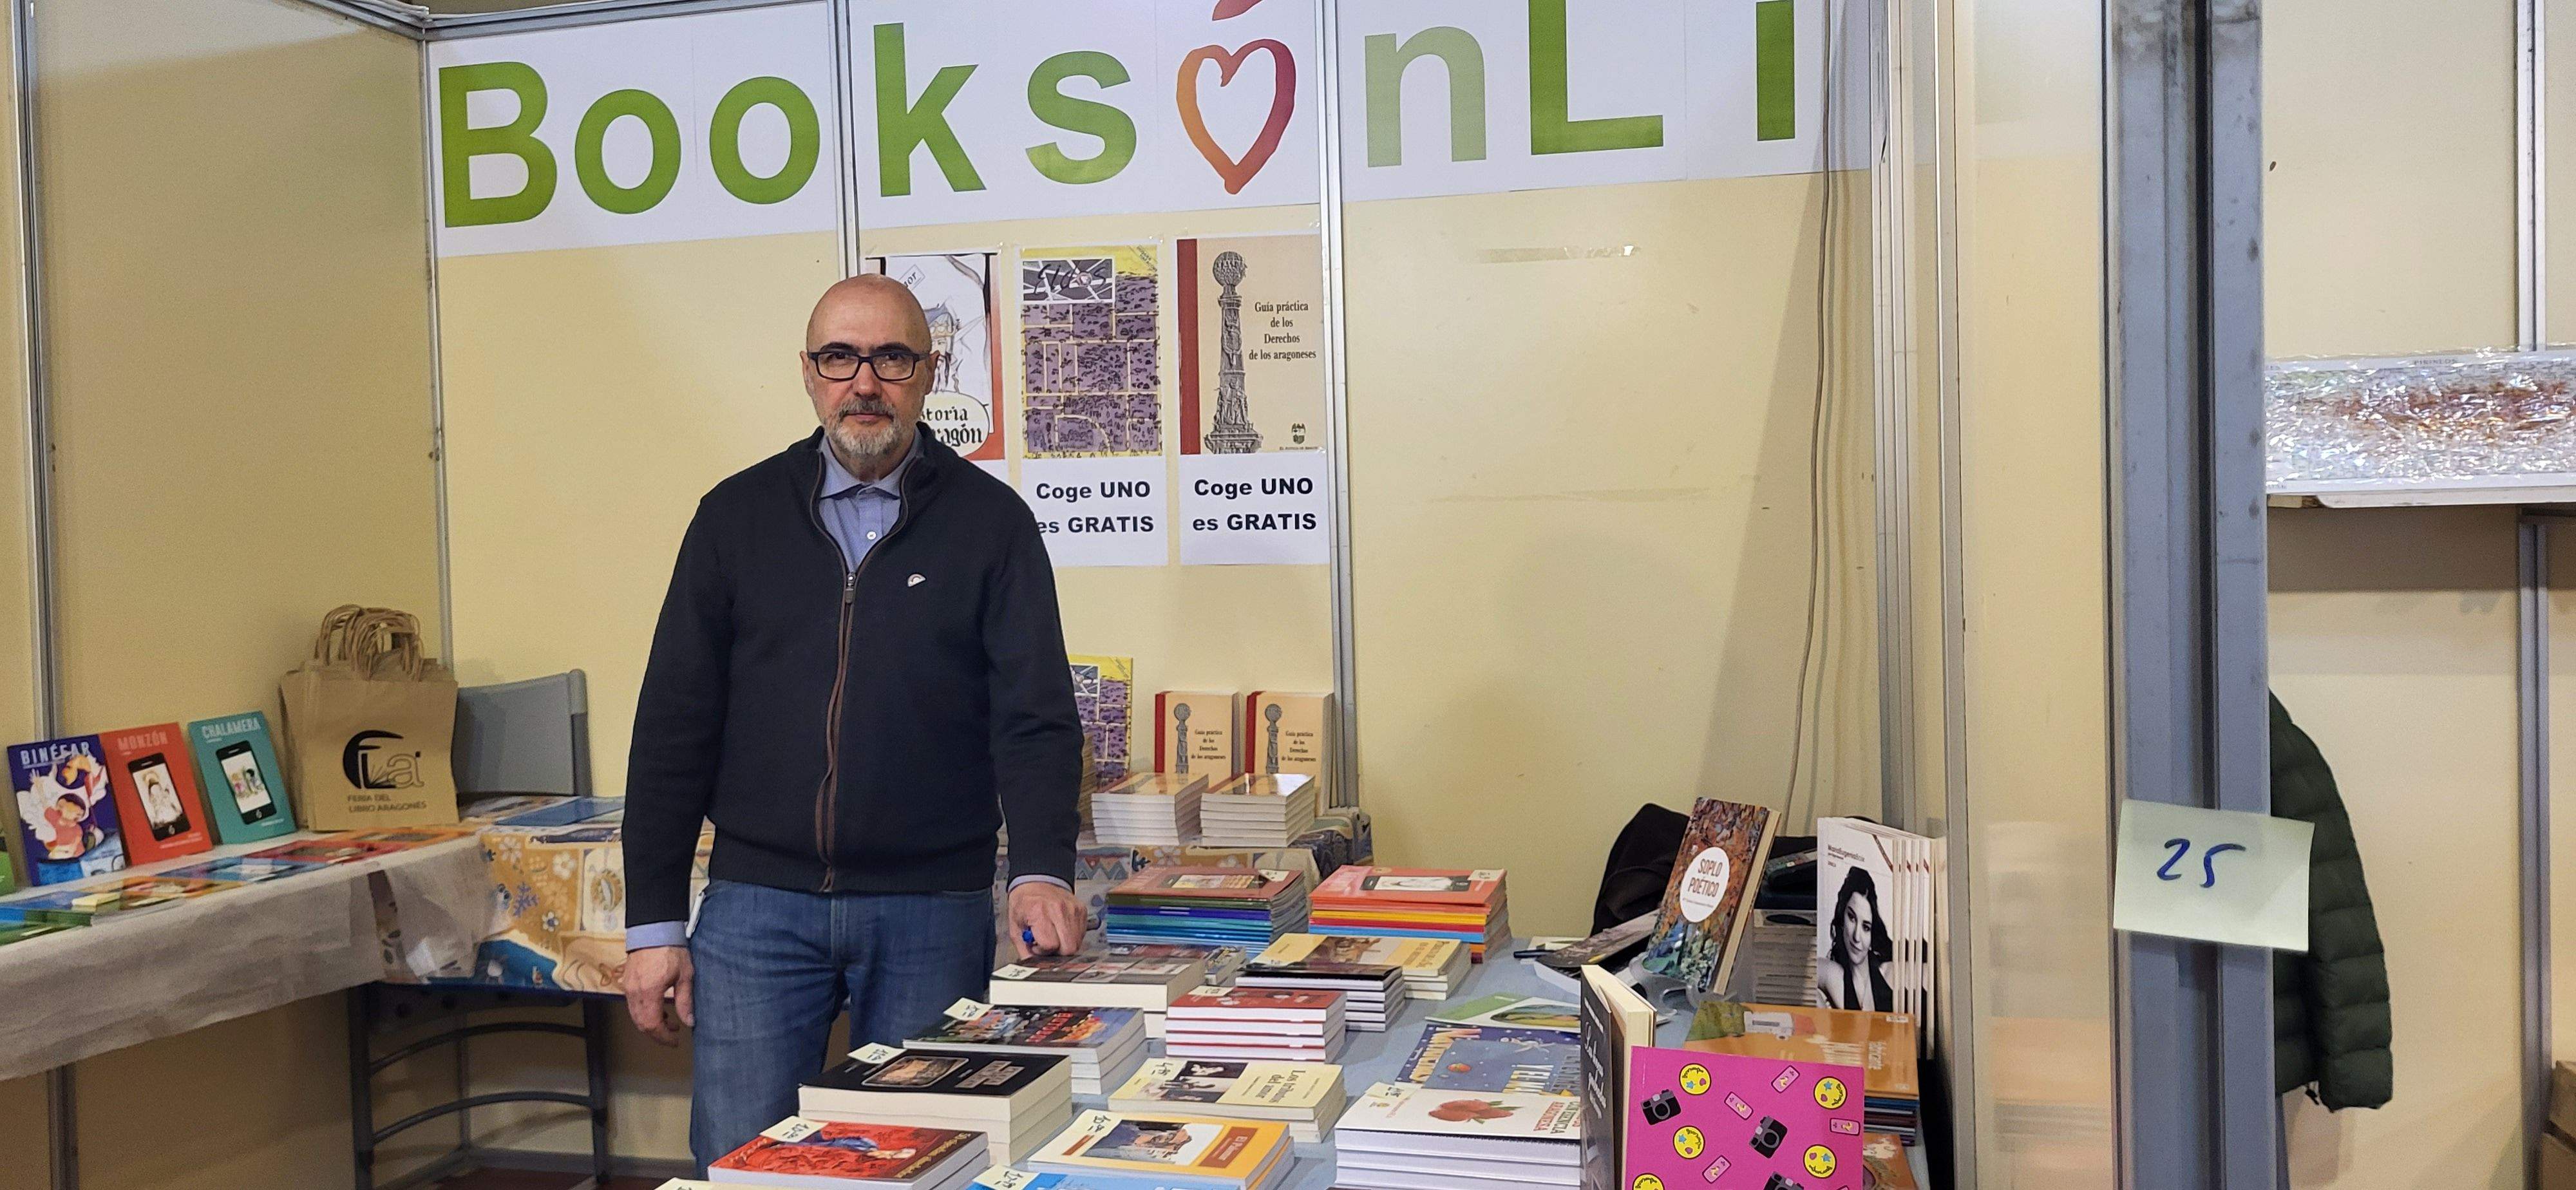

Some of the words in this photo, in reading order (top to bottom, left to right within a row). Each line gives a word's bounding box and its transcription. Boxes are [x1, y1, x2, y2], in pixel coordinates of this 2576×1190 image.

[1255, 301, 1274, 312] Guía
[1276, 300, 1309, 314] práctica
[1271, 317, 1280, 328] de
[1282, 317, 1293, 327] los
[1264, 332, 1300, 344] Derechos
[1249, 350, 1258, 360] de
[1260, 350, 1271, 360] los
[1274, 351, 1316, 361] aragoneses
[1036, 483, 1092, 503] Coge
[1100, 481, 1151, 498] UNO
[1194, 479, 1253, 500] Coge
[1261, 478, 1313, 495] UNO
[1037, 520, 1059, 533] es
[1068, 515, 1154, 533] GRATIS
[1192, 518, 1219, 531] es
[1227, 513, 1317, 531] GRATIS
[374, 793, 391, 802] DEL
[1698, 858, 1723, 878] SOPLO
[2157, 838, 2246, 889] 25
[1687, 876, 1719, 898] POÉTICO
[1287, 1070, 1306, 1082] Los
